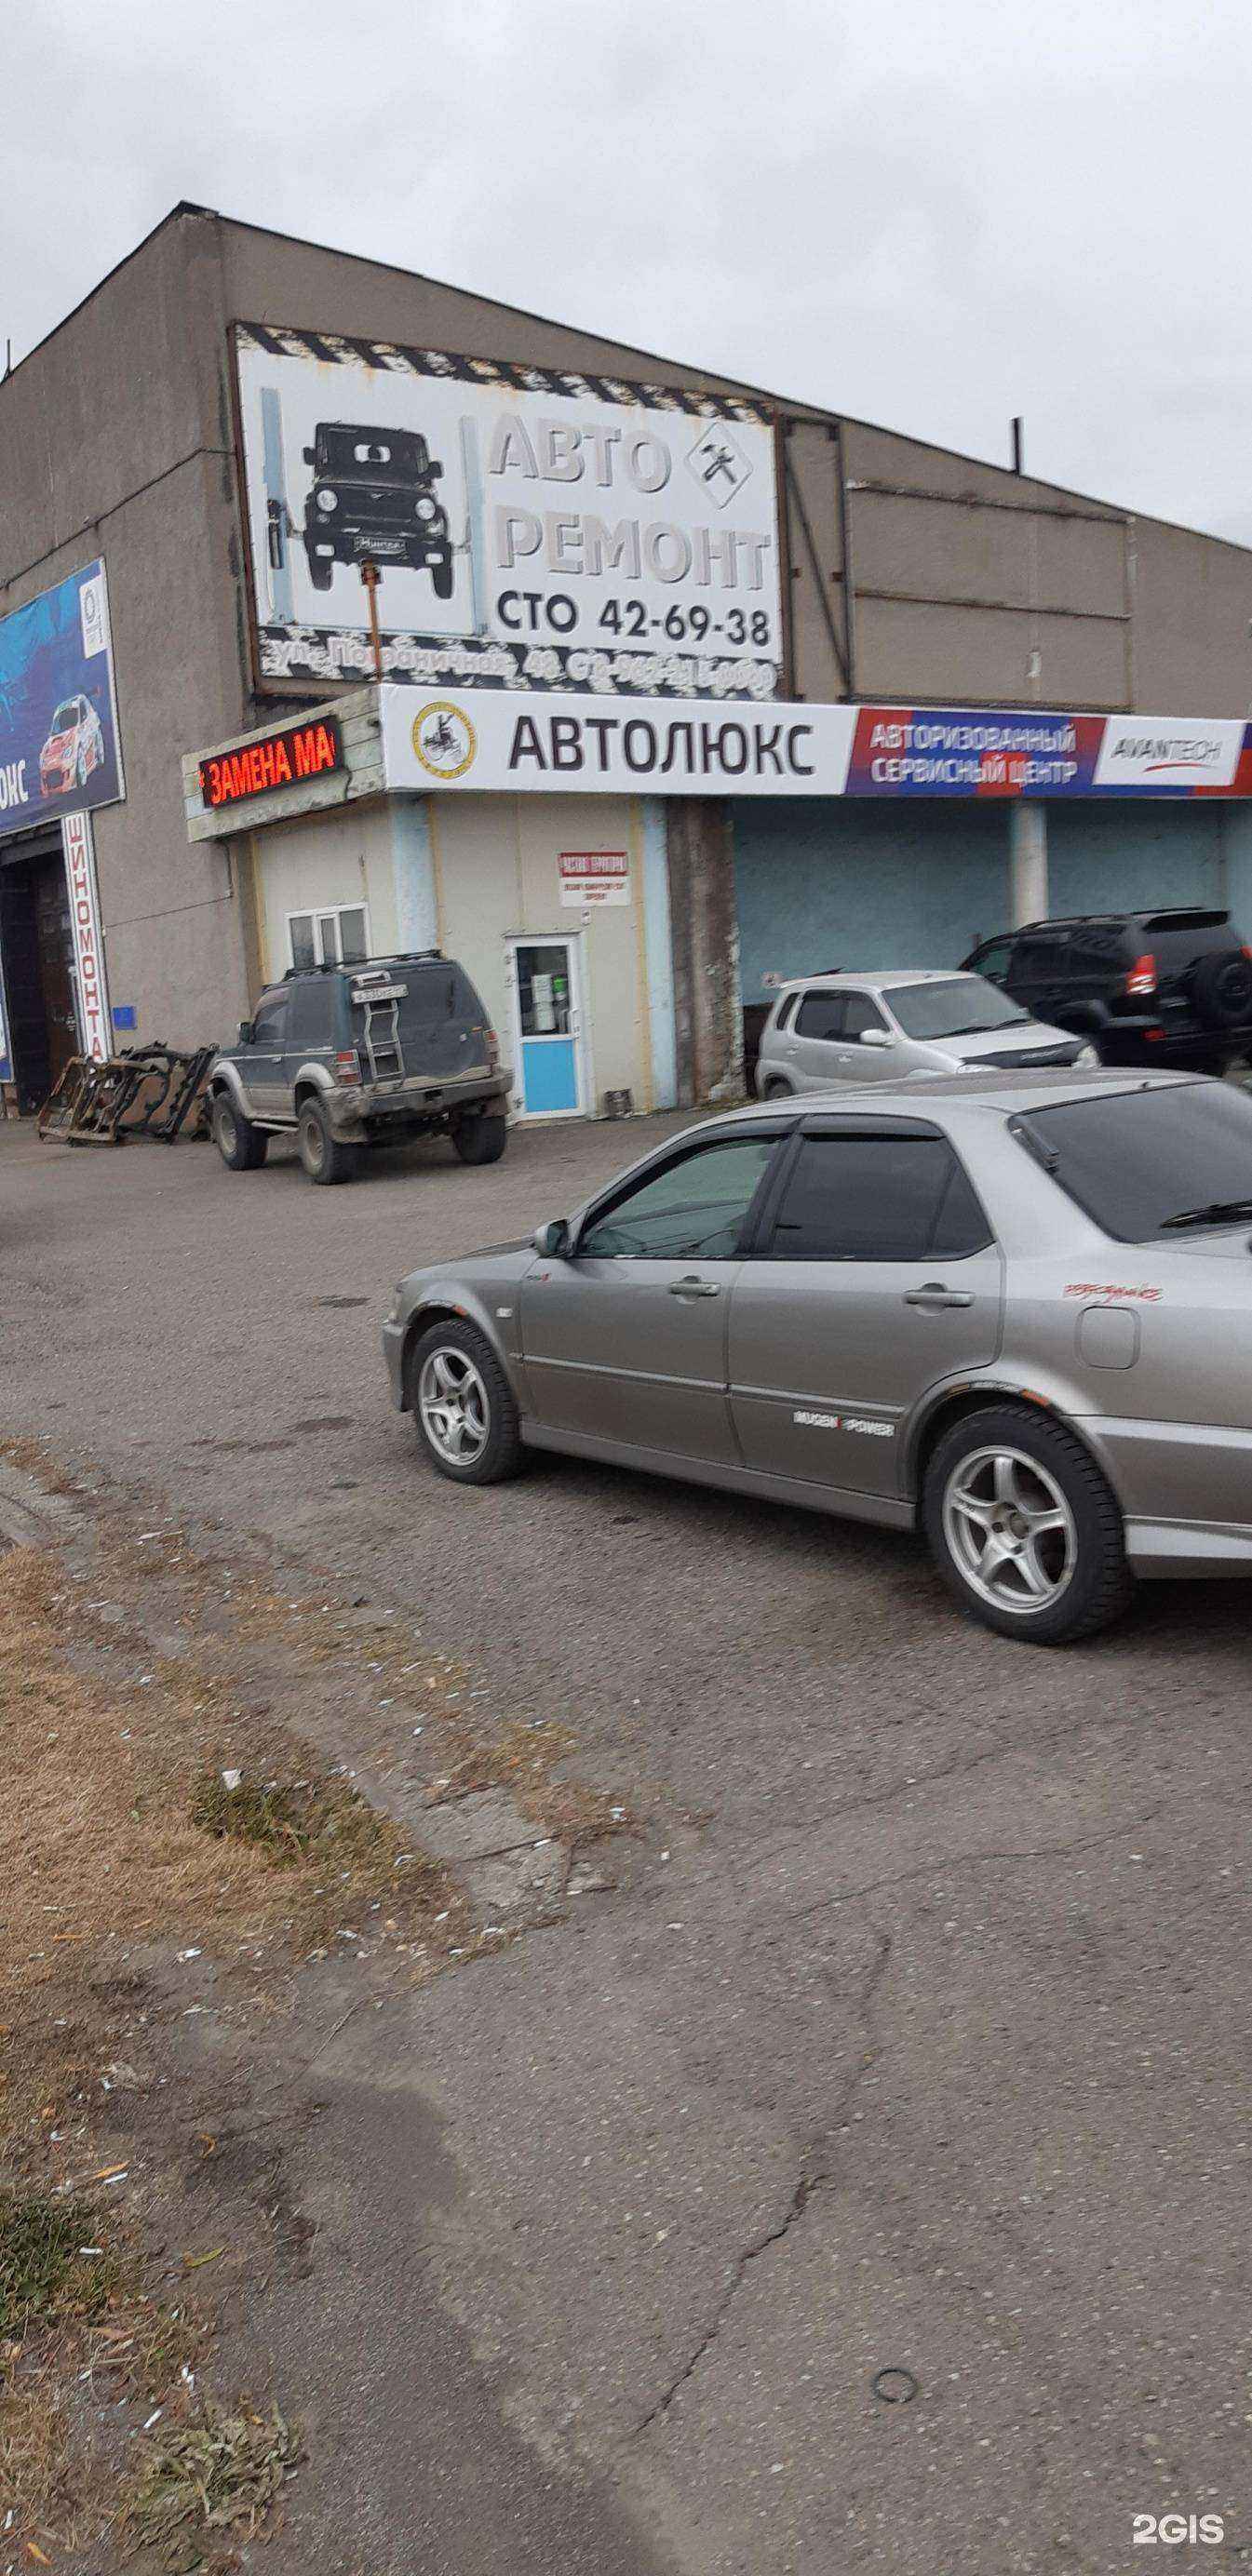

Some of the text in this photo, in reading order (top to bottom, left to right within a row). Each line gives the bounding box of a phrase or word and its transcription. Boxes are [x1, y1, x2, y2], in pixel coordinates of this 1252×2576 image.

[488, 414, 673, 494] АВТО
[494, 503, 773, 592] РЕМОНТ
[497, 589, 770, 648] СТО 42-69-38
[208, 724, 336, 805] ЗАМЕНА МА
[507, 715, 816, 776] АВТОЛЮКС
[869, 722, 1077, 753] АВТОРИЗОВАННЫЙ
[870, 754, 1078, 787] СЕРВИСНЫЙ ЦЕНТР
[67, 815, 104, 1060] ШИНОМОНТА
